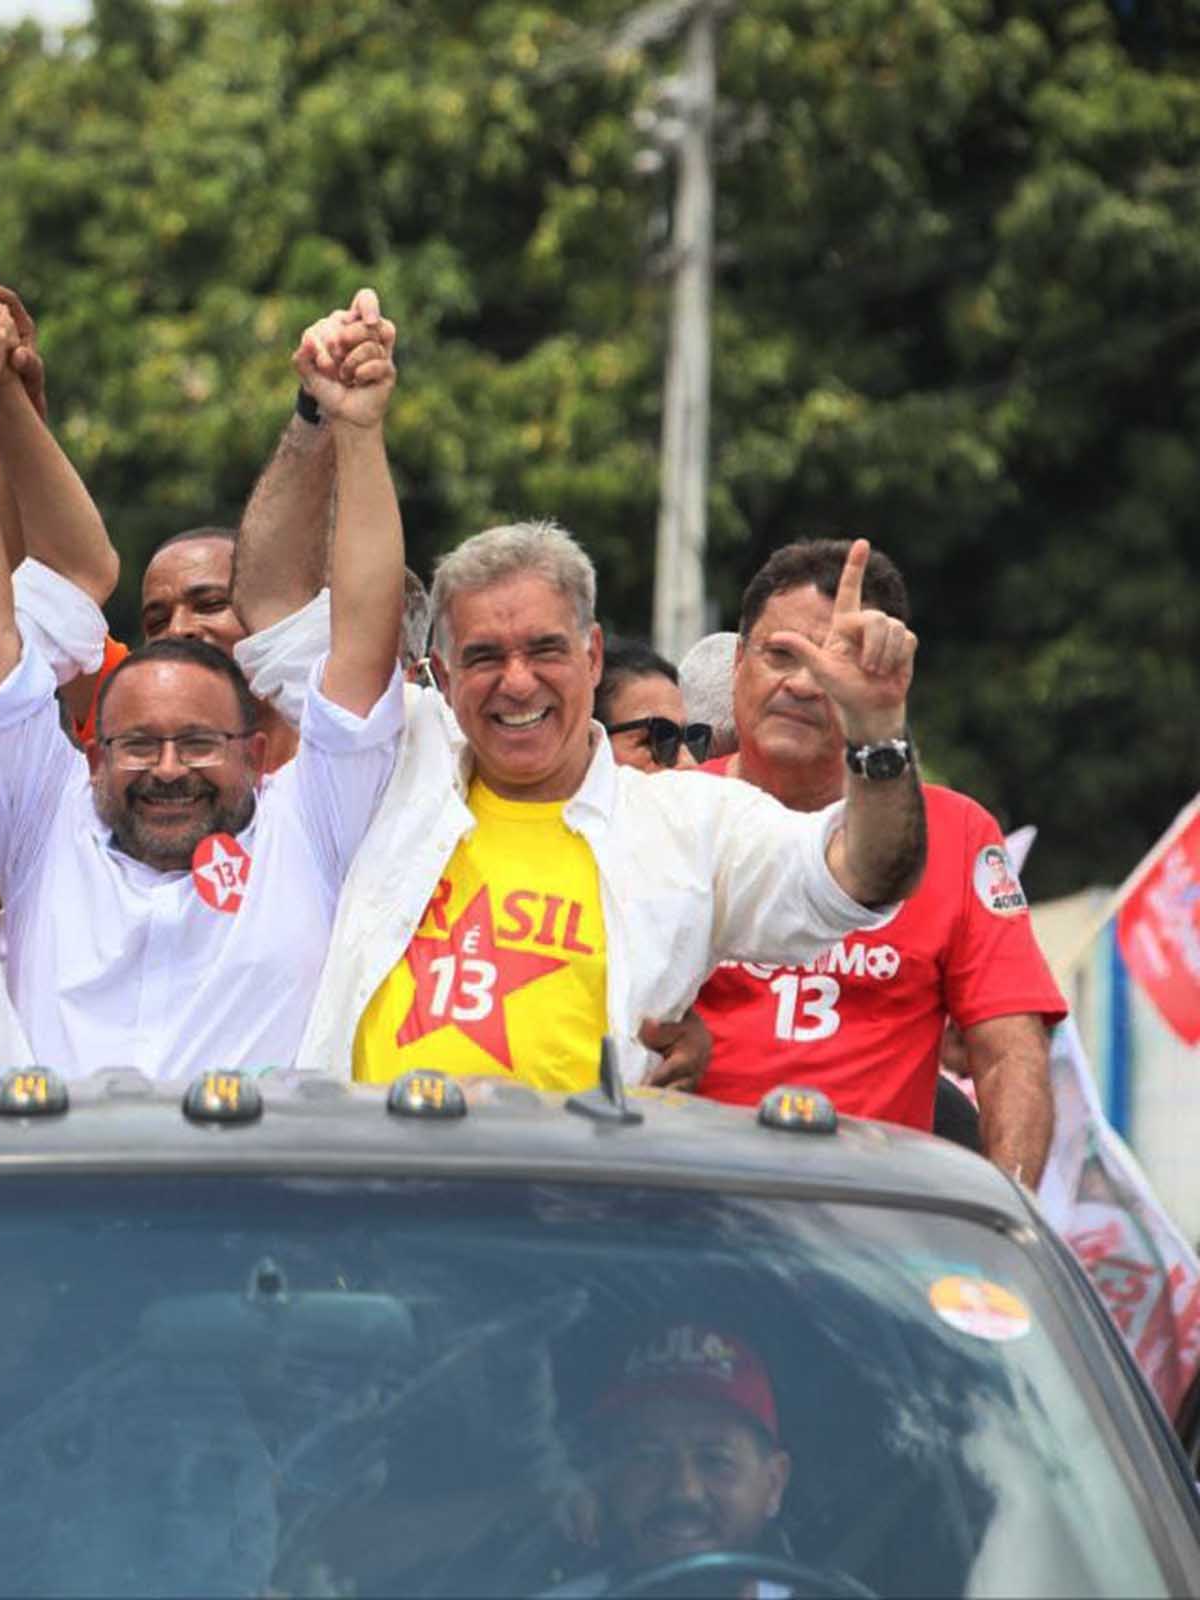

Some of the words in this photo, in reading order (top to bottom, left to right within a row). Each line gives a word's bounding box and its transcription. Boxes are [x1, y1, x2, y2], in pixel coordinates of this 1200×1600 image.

[213, 861, 237, 888] 13
[461, 924, 481, 954] É
[428, 954, 498, 1021] 13
[769, 973, 841, 1041] 13
